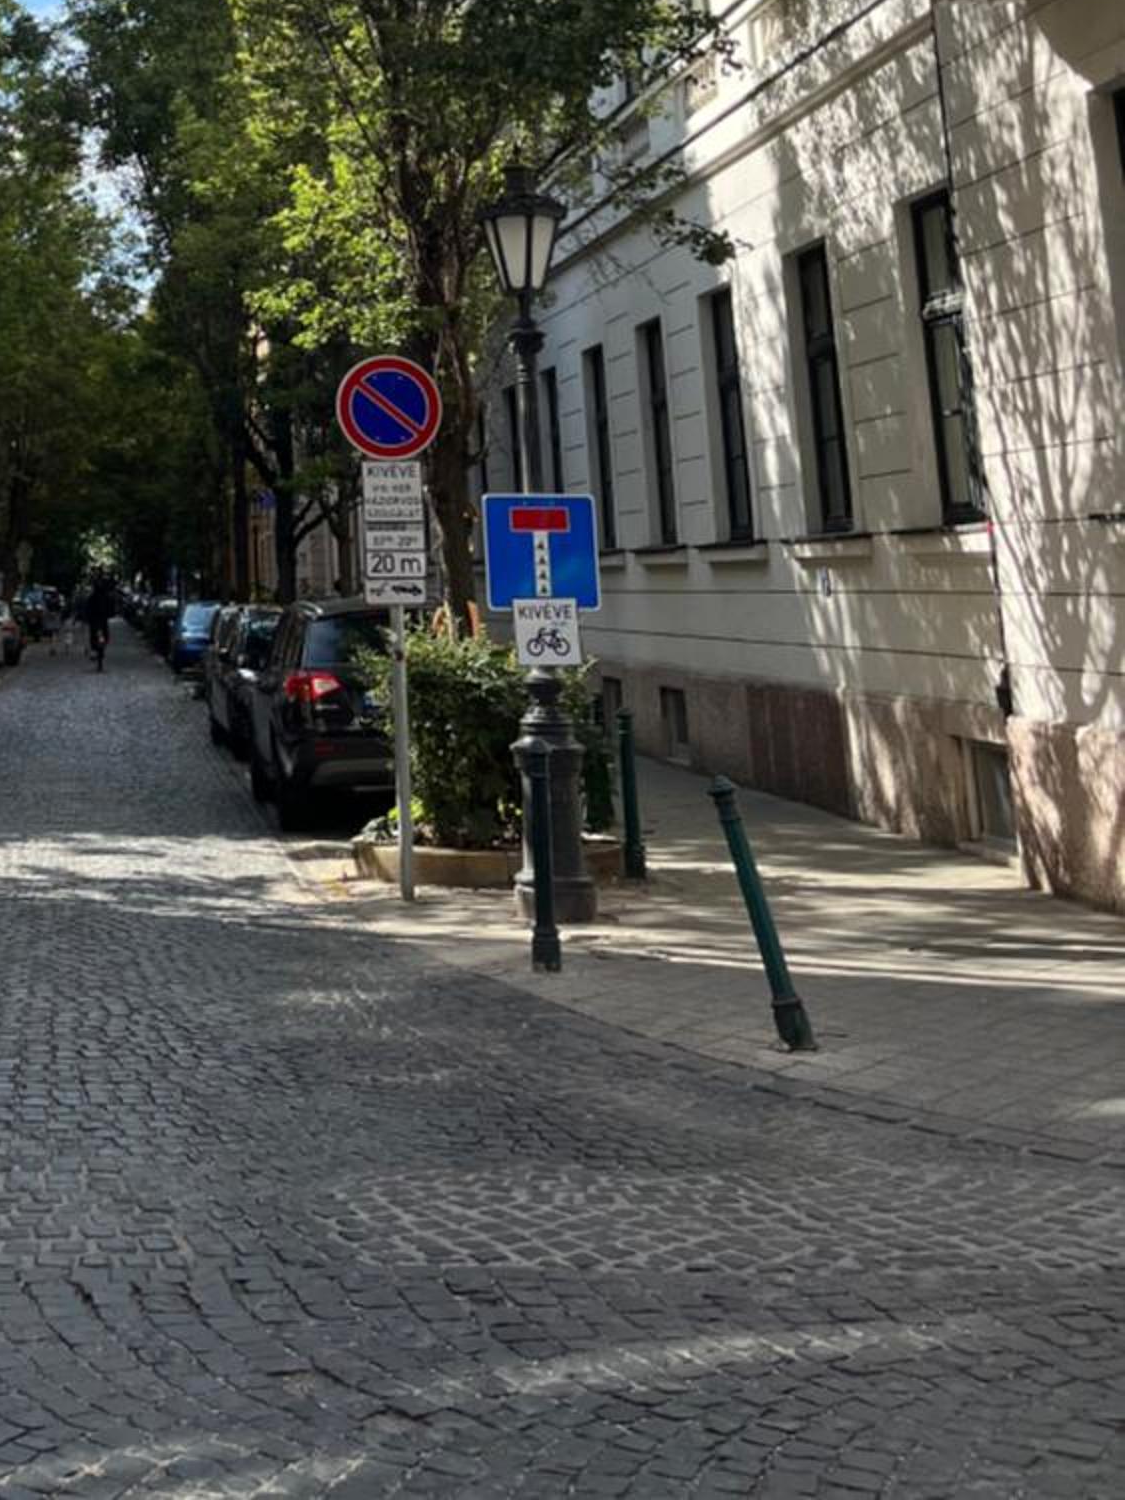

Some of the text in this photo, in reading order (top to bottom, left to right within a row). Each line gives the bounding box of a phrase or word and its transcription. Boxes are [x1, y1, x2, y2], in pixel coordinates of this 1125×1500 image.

[367, 464, 417, 479] KIVÉVE
[371, 553, 422, 573] 20 m
[517, 602, 573, 620] KIVÉVE
